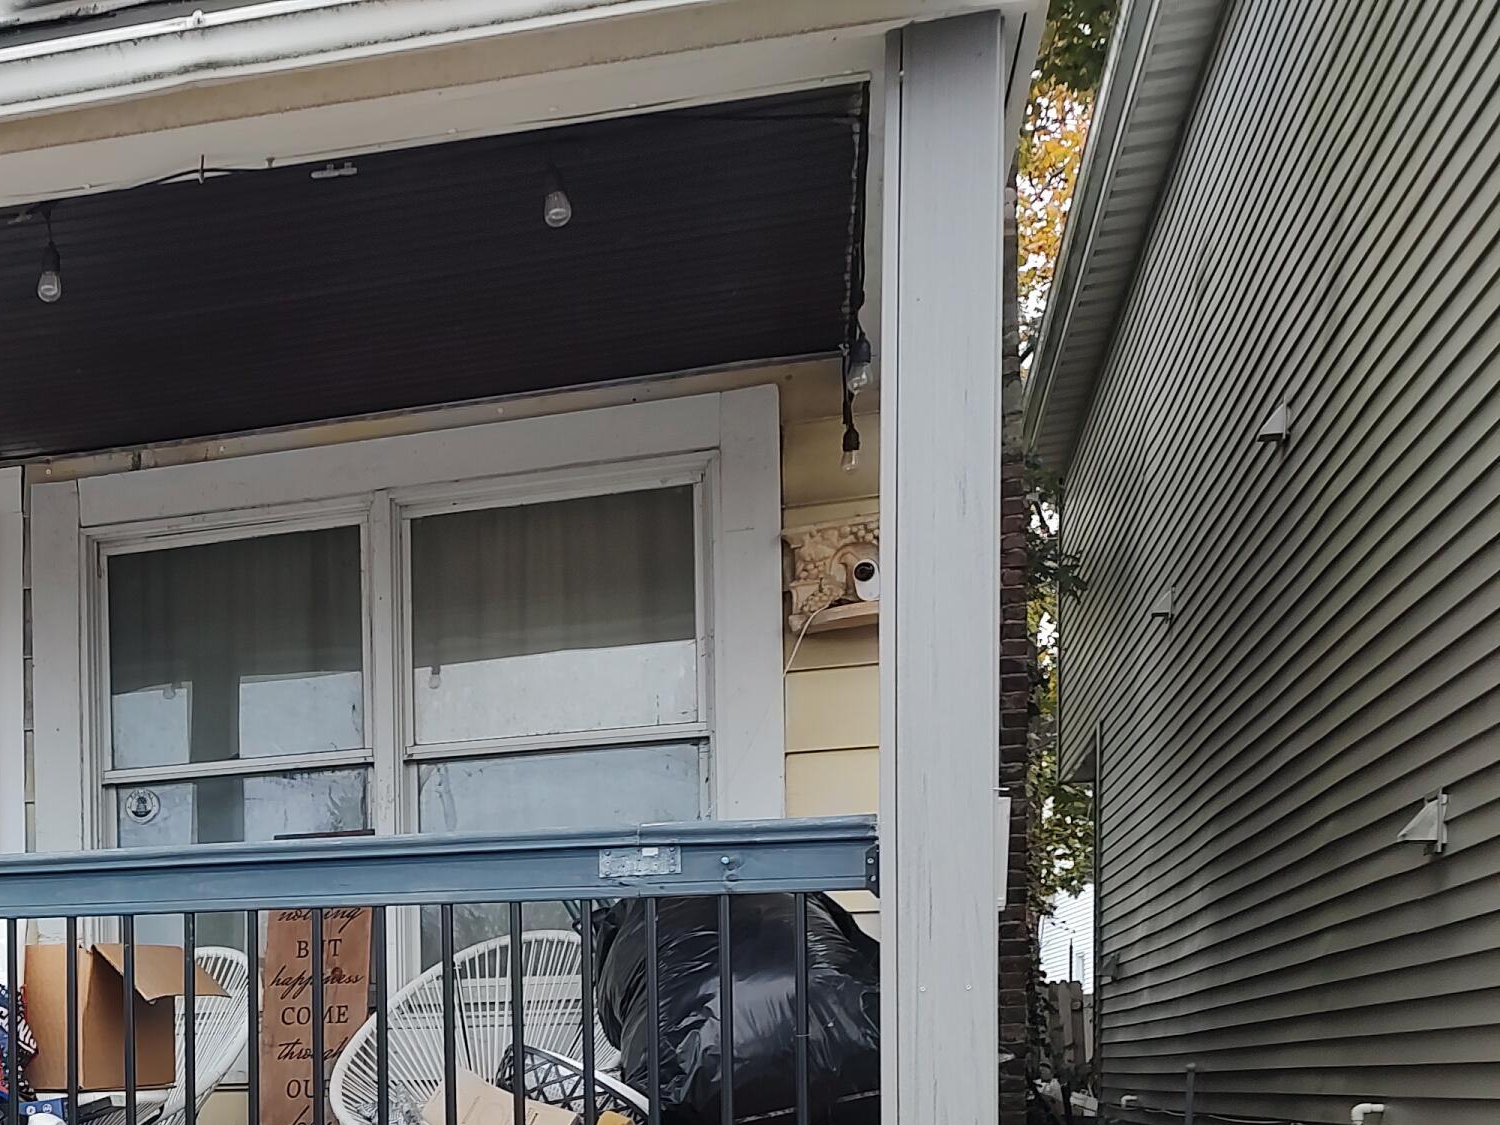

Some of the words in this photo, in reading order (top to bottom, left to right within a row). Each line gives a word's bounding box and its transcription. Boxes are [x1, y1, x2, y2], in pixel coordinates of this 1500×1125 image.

[296, 939, 342, 958] BT
[270, 965, 364, 1000] happness
[286, 1079, 330, 1099] OU
